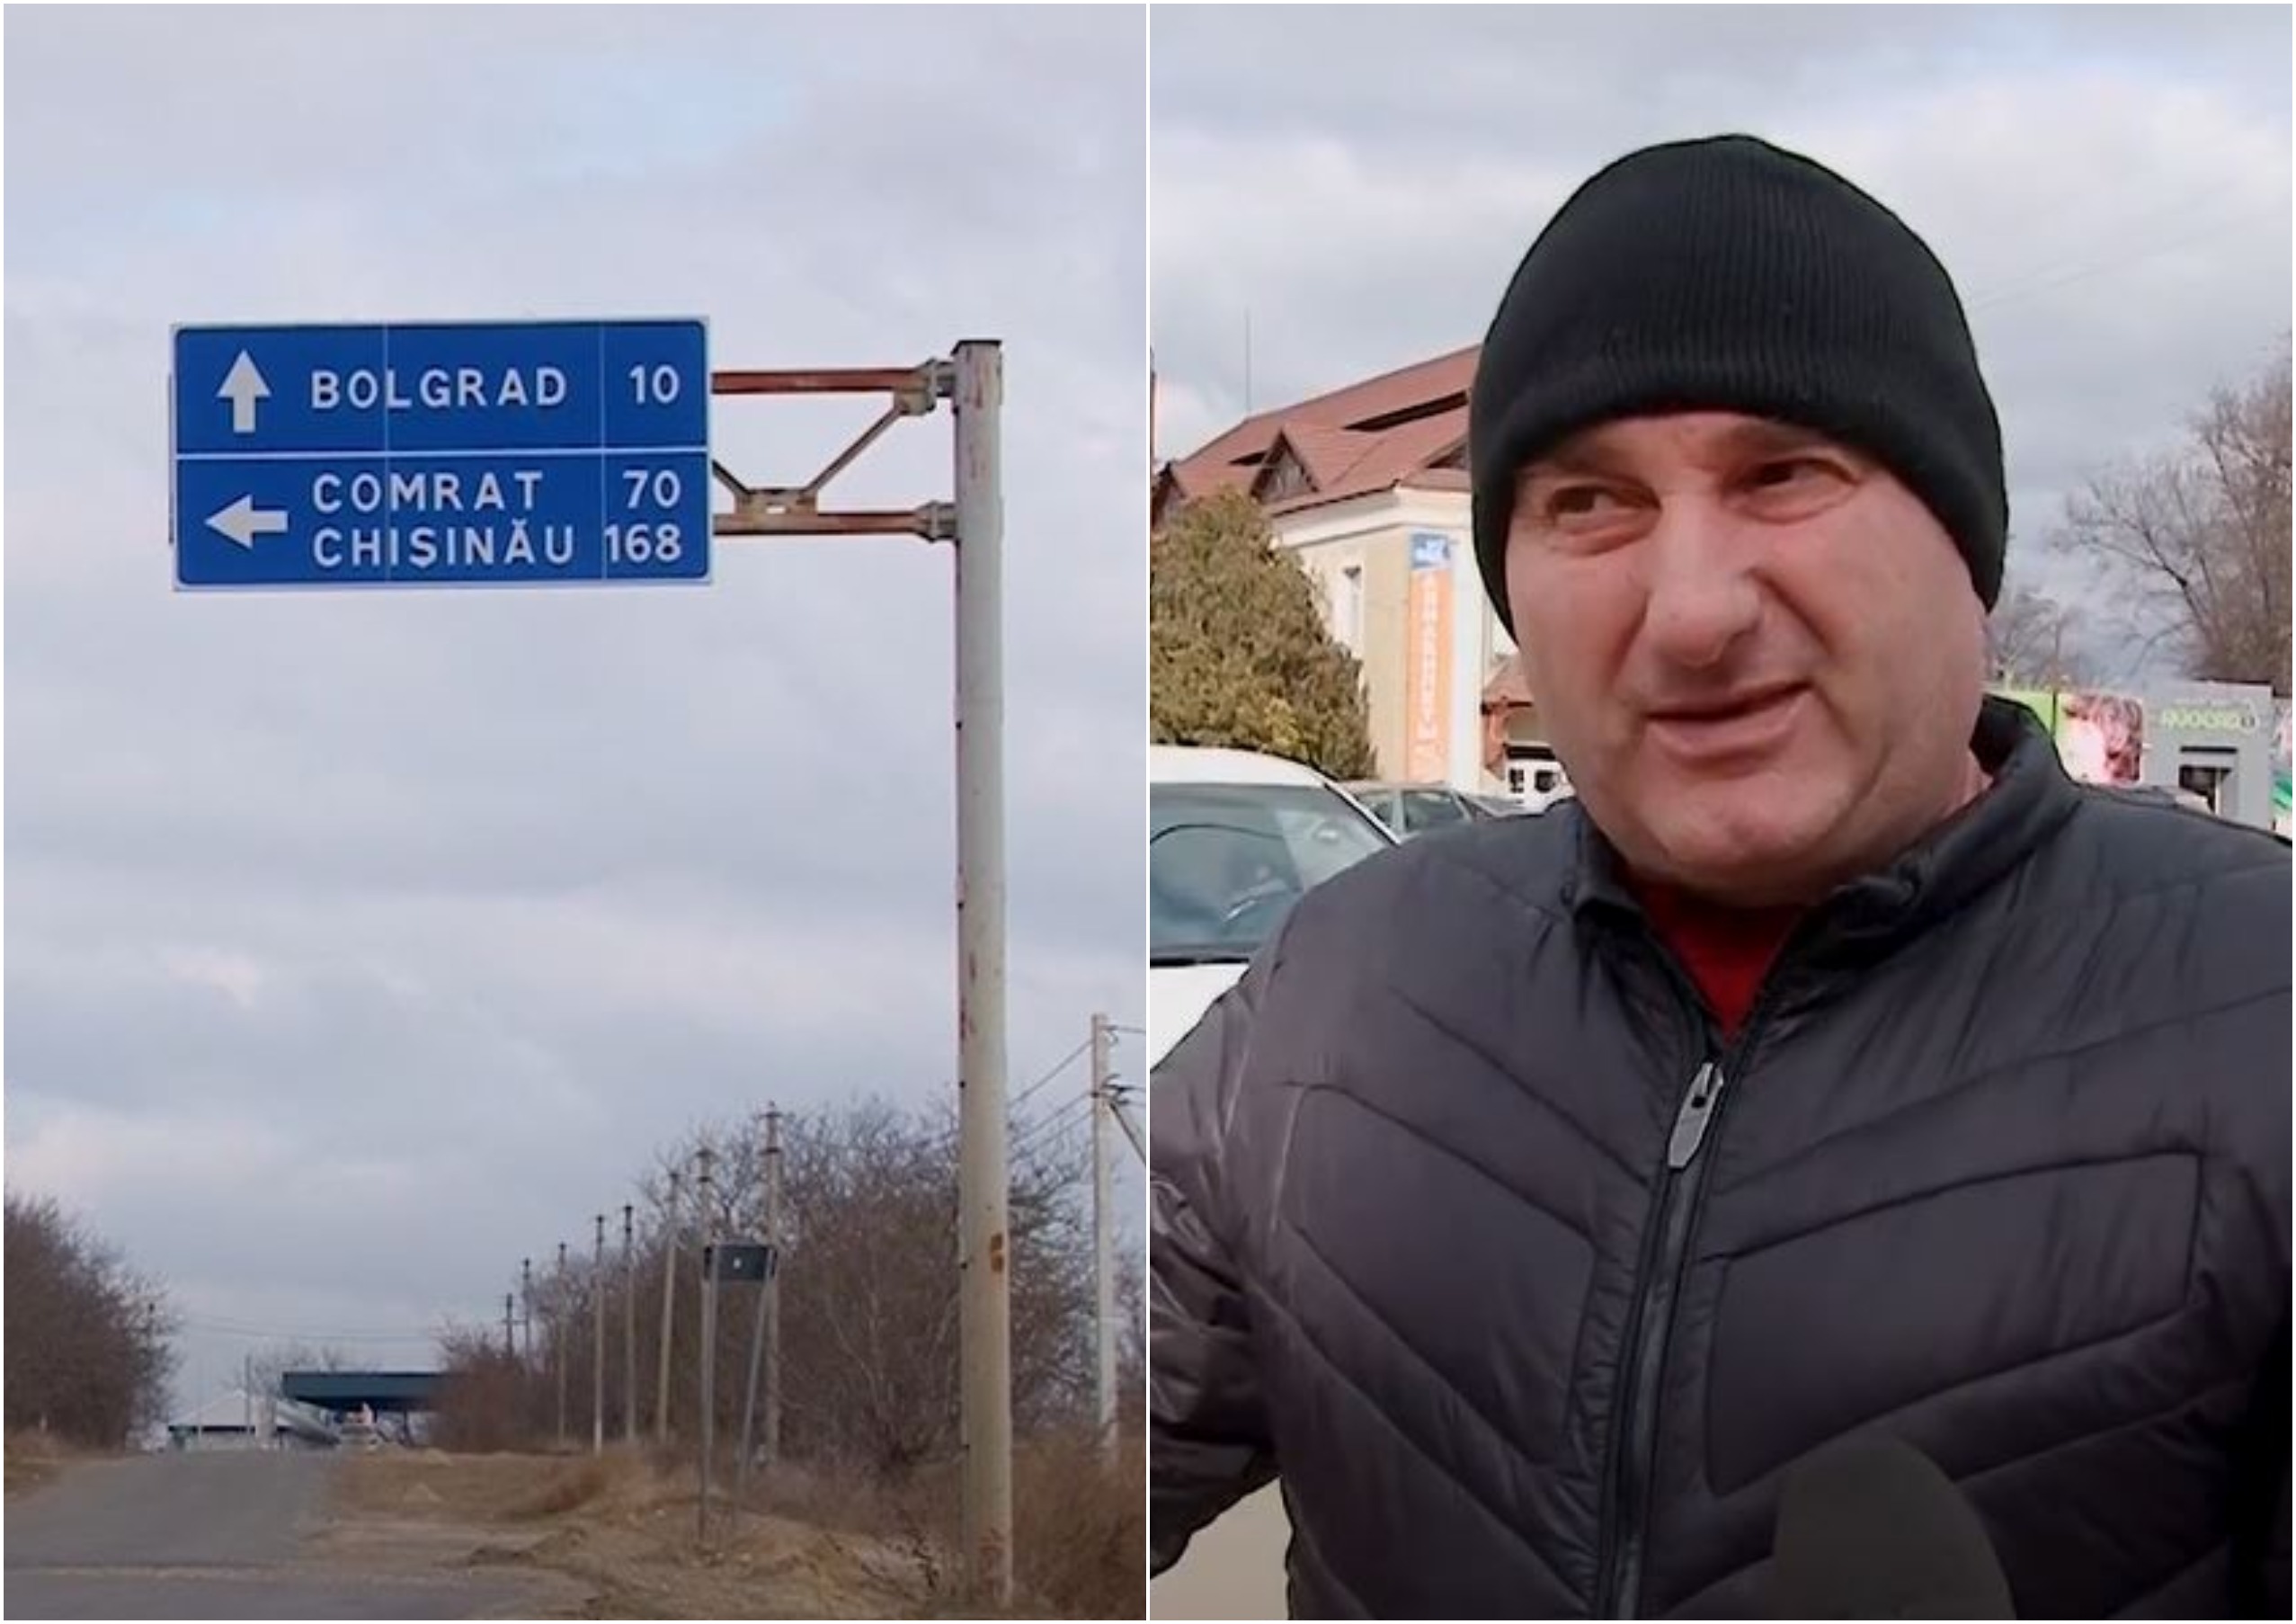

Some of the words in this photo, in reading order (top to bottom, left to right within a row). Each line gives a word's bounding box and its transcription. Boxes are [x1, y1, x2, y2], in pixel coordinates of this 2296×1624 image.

[312, 368, 565, 408] BOLGRAD
[630, 365, 679, 403] 10
[314, 471, 542, 513] COMRAT
[623, 470, 681, 508] 70
[604, 524, 681, 562] 168
